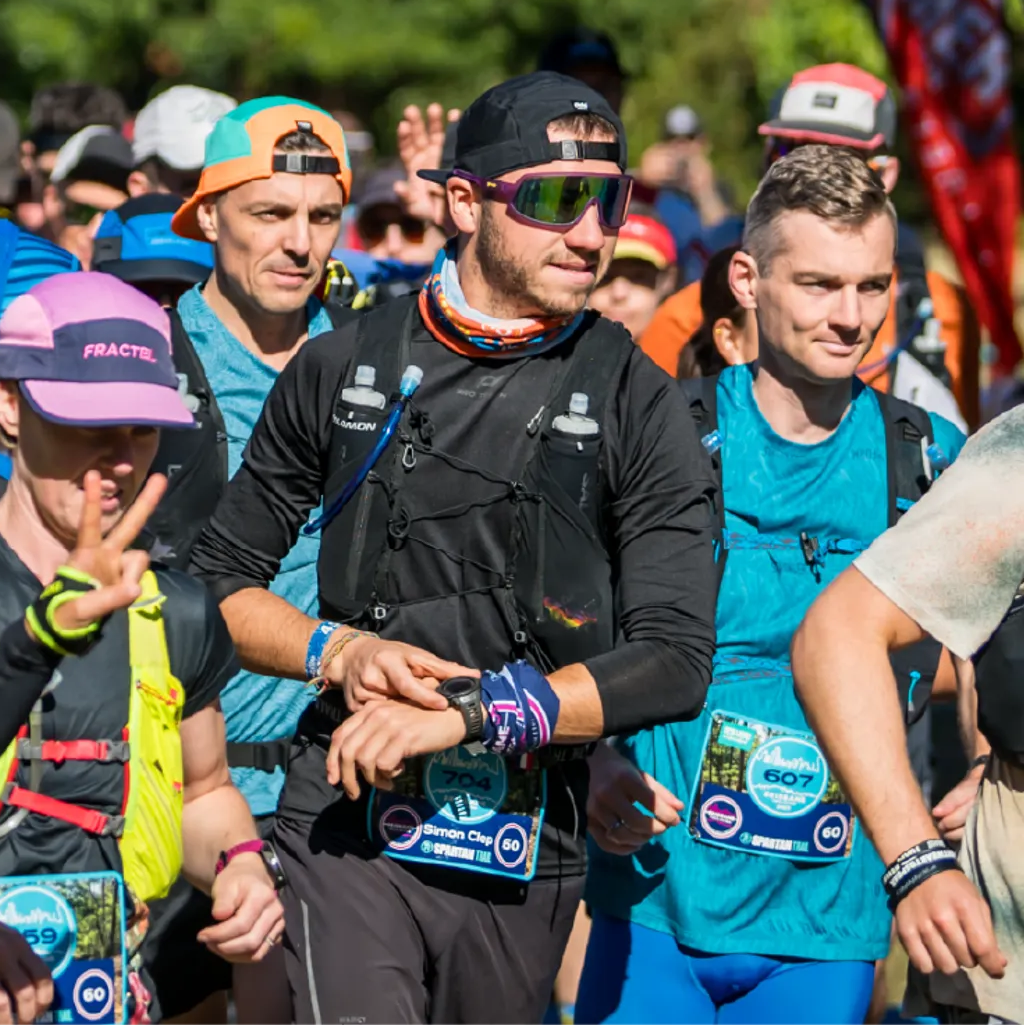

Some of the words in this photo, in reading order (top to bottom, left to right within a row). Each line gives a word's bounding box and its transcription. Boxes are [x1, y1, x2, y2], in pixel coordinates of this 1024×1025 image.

[82, 342, 157, 364] FRACTEL
[441, 770, 492, 792] 704
[763, 768, 815, 789] 607
[423, 824, 465, 840] Simon
[821, 826, 842, 839] 60
[433, 842, 475, 861] SPARTAN
[750, 834, 793, 851] SPARTAN
[24, 927, 58, 945] 59
[82, 987, 106, 1003] 60
